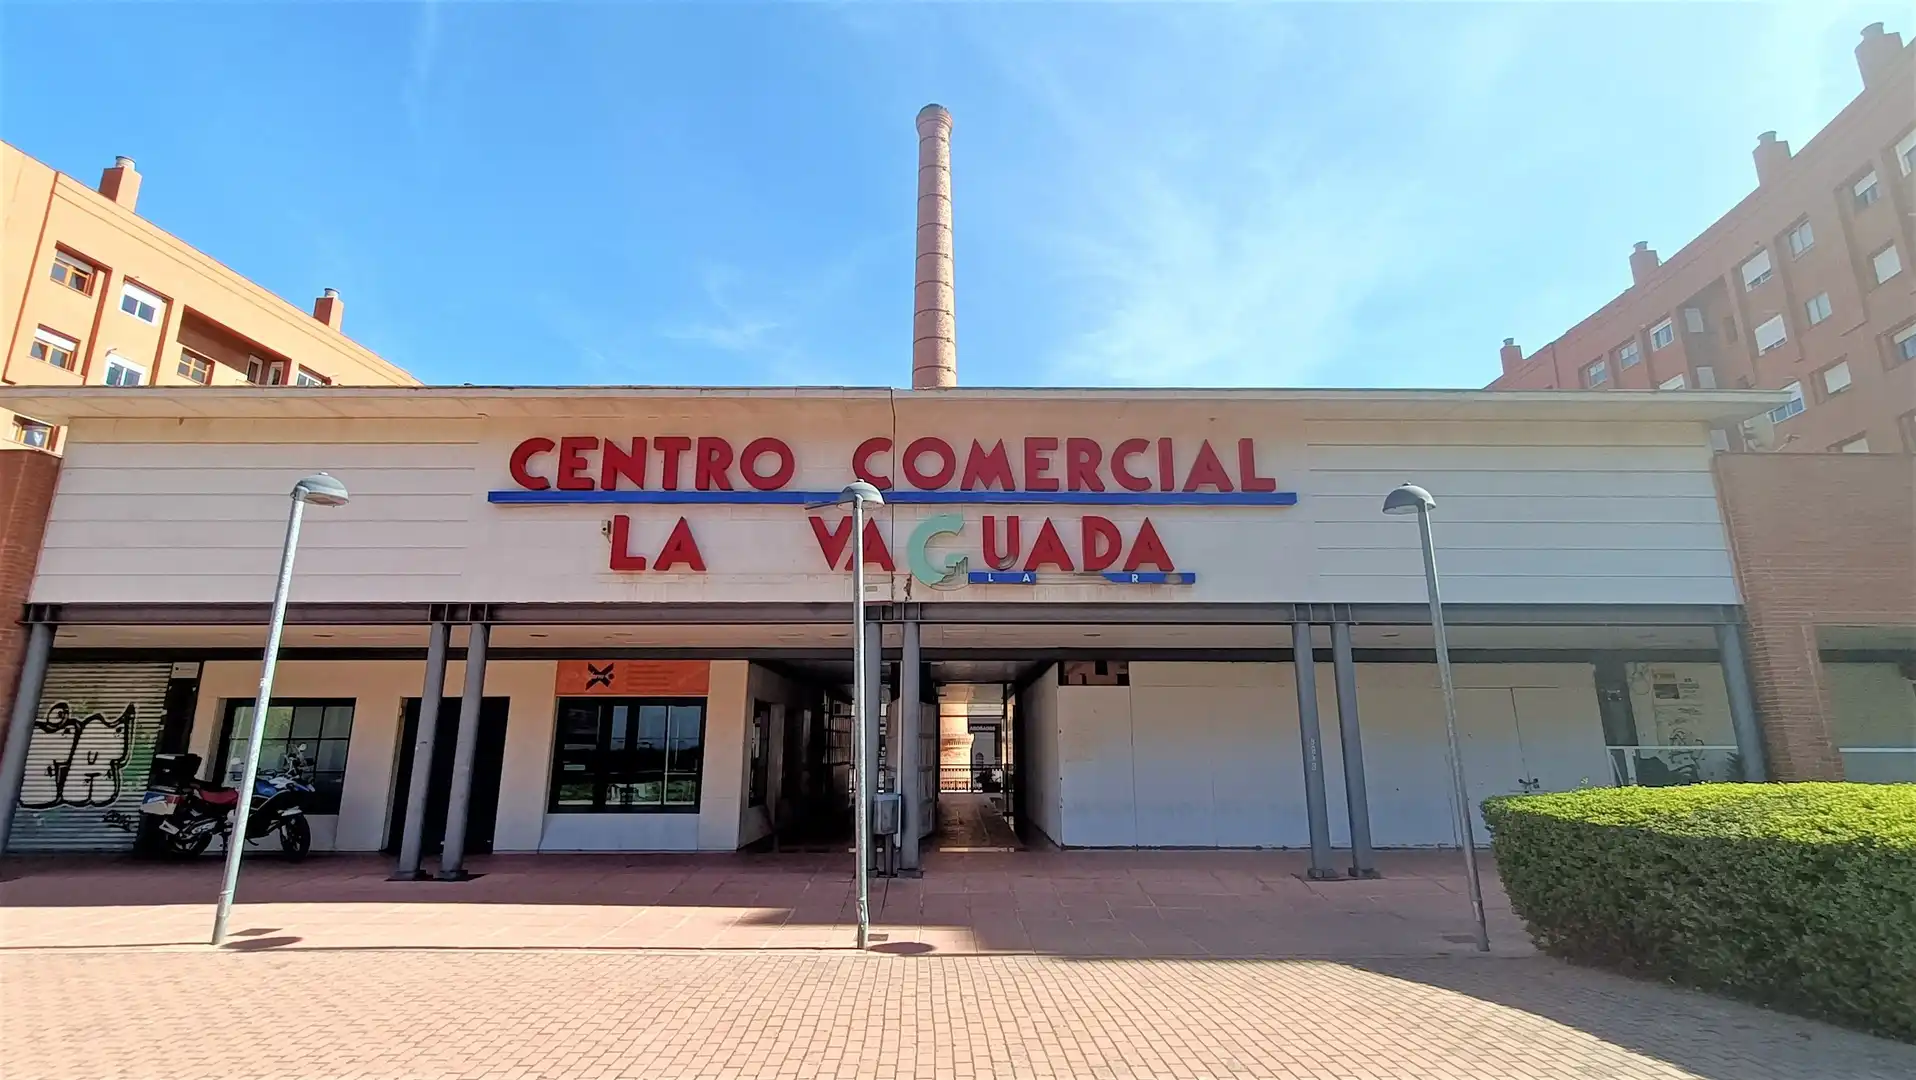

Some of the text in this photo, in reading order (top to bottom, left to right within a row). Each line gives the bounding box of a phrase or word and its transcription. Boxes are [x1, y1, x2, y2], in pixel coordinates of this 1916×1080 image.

[509, 436, 1277, 492] CENTRO COMERCIAL
[609, 513, 1175, 590] LA VAGUADA
